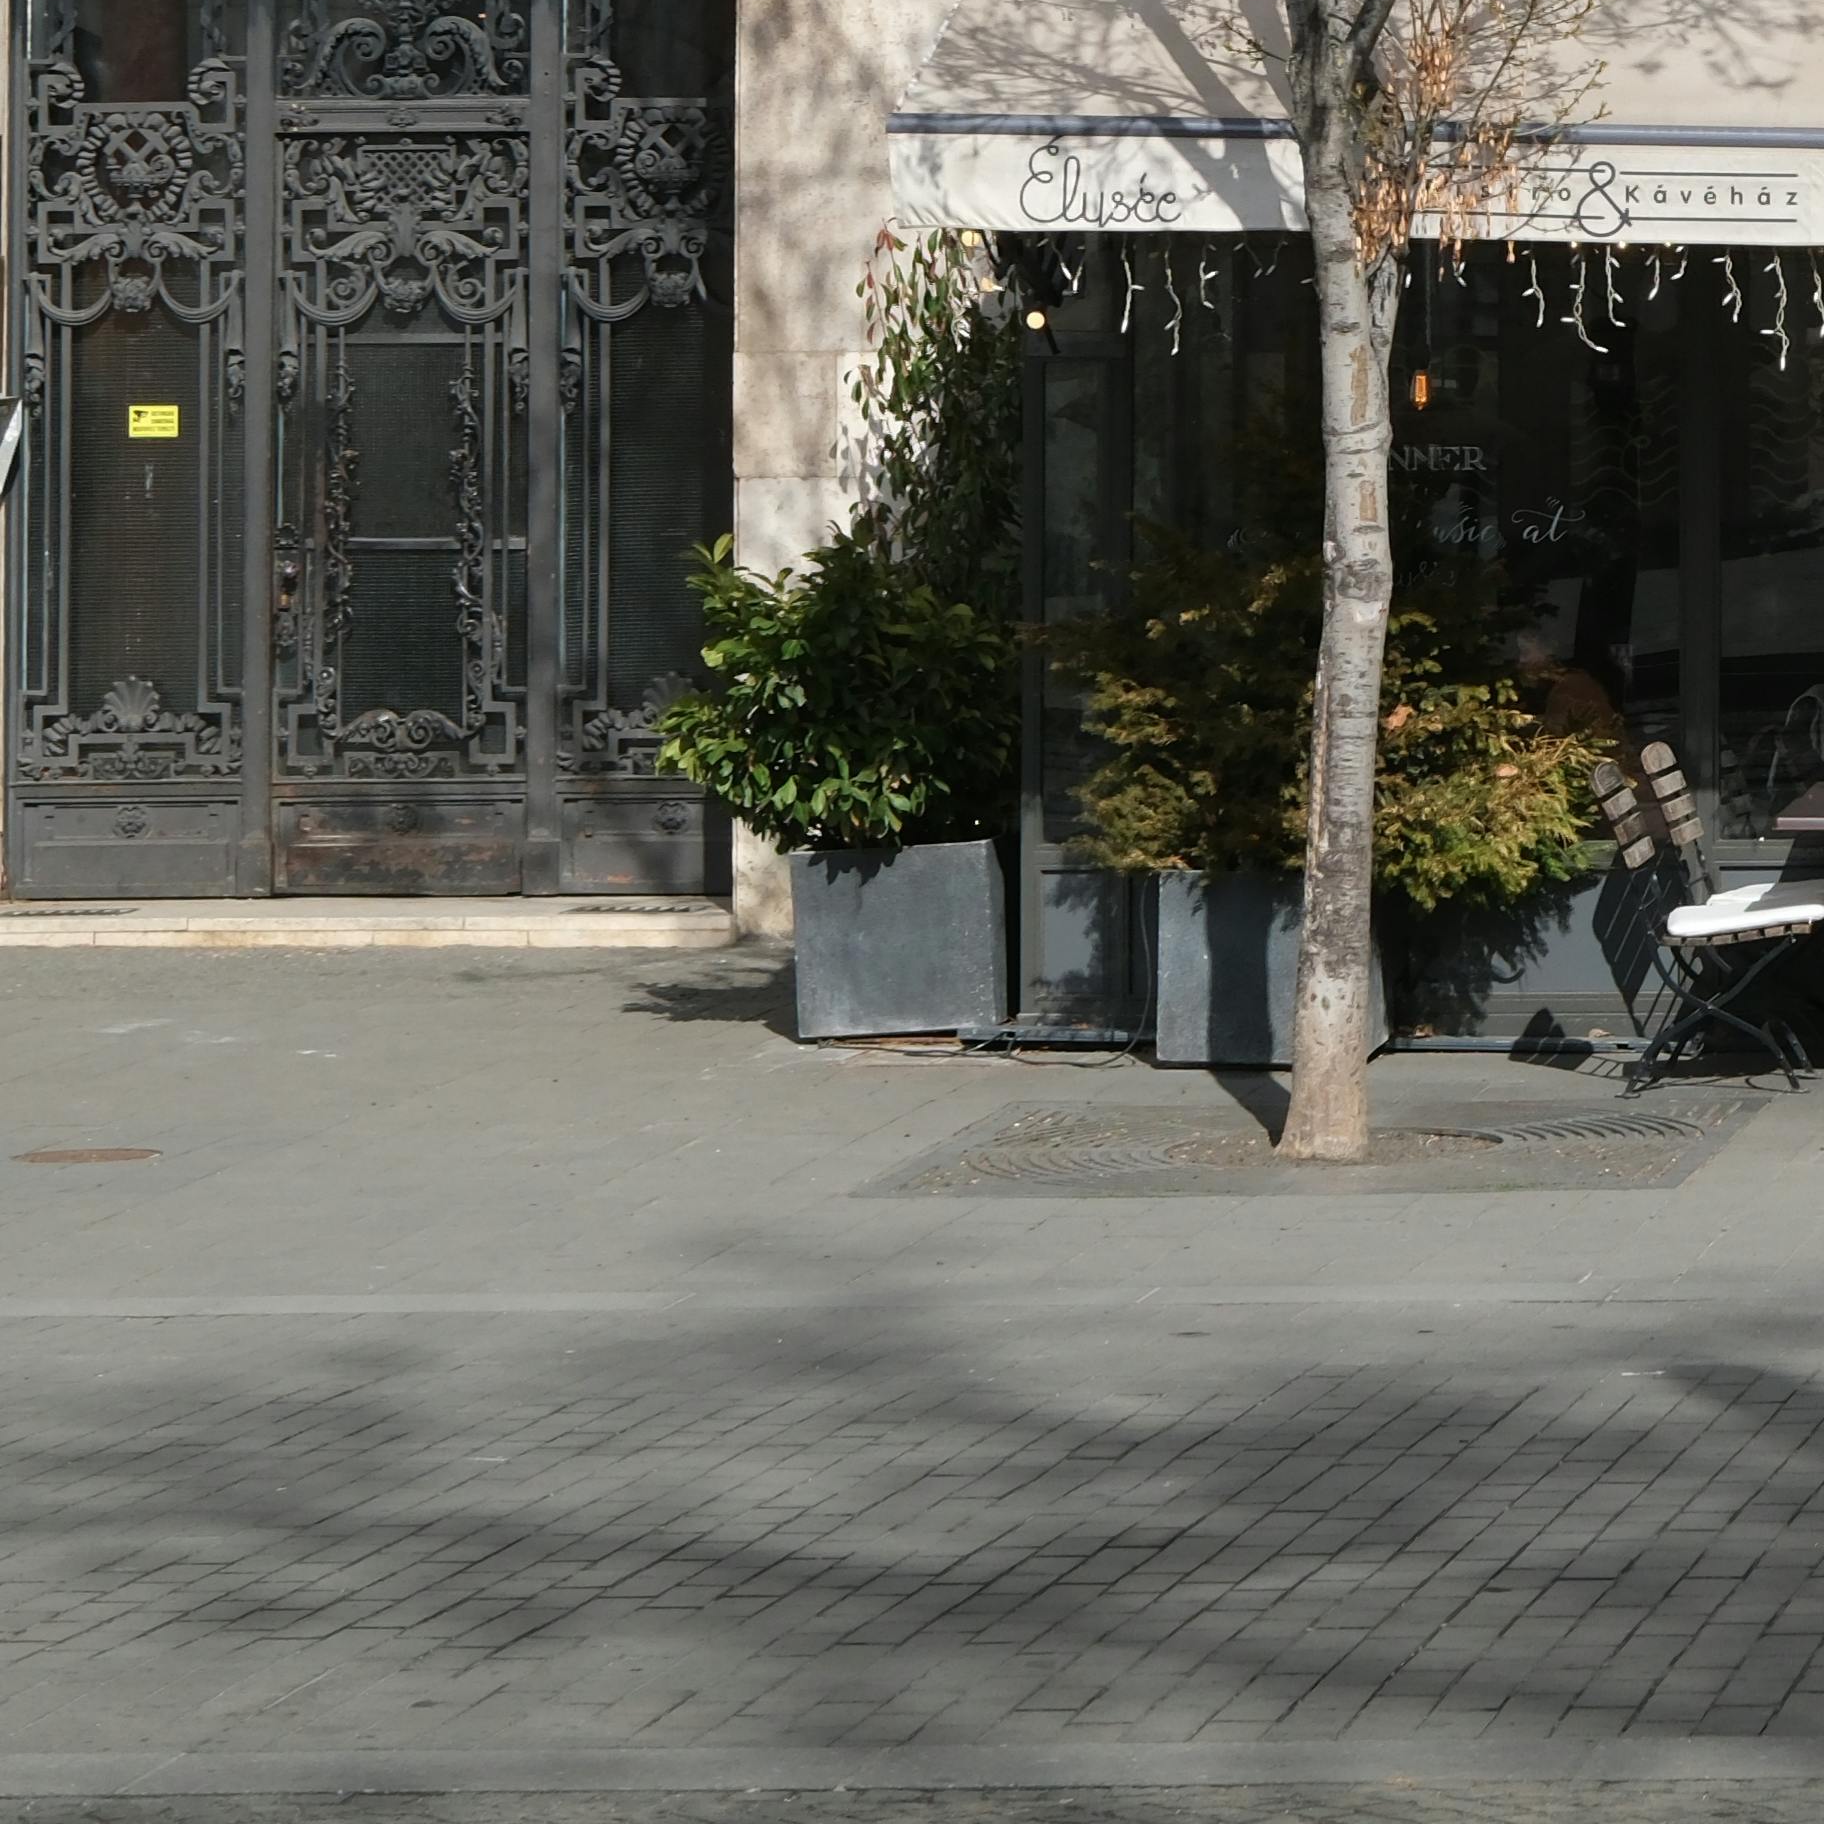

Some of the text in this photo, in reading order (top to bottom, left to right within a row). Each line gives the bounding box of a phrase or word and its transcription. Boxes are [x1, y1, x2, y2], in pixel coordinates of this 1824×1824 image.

[1577, 161, 1632, 237] &
[1625, 185, 1798, 206] Kávéház
[1389, 445, 1488, 472] NNER
